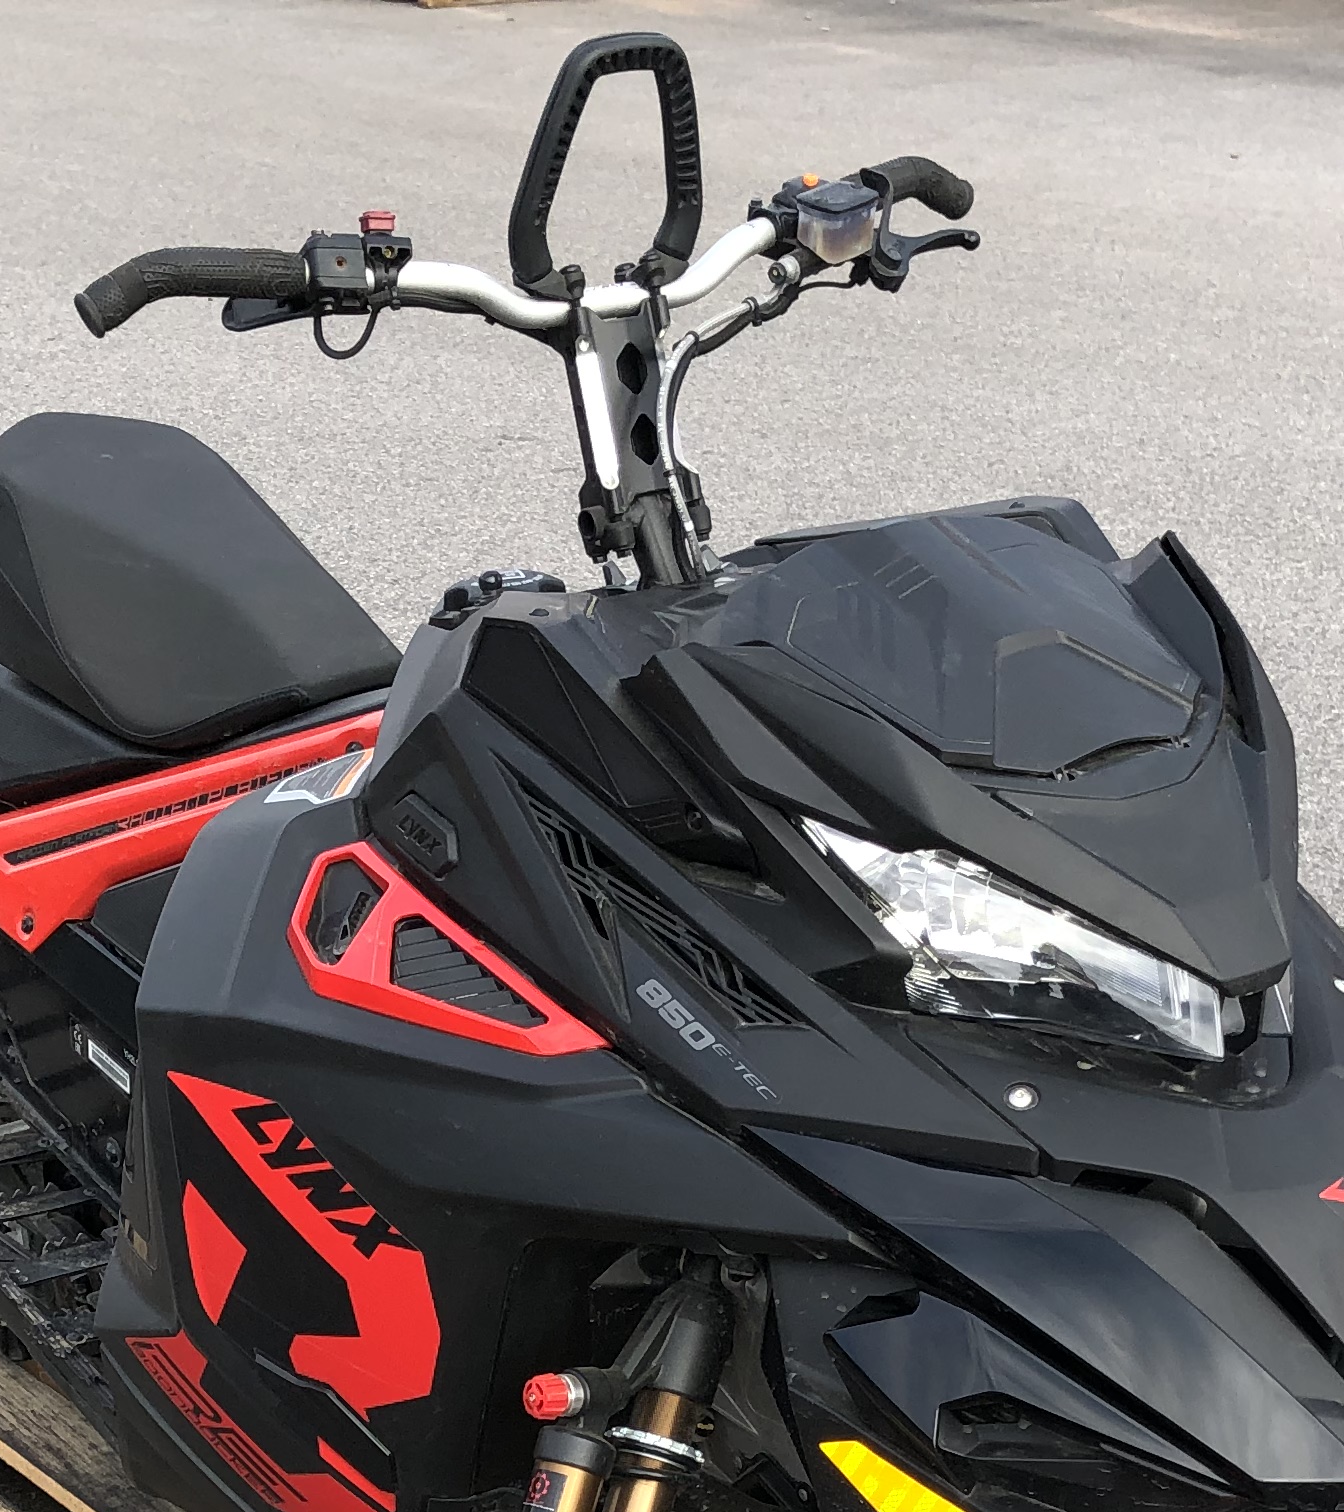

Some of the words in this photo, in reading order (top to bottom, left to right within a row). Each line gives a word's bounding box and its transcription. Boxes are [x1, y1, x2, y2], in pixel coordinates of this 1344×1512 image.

[396, 813, 444, 858] LYNX
[635, 978, 717, 1052] 850
[709, 1043, 778, 1102] E-TEC
[231, 1102, 422, 1260] LYNX
